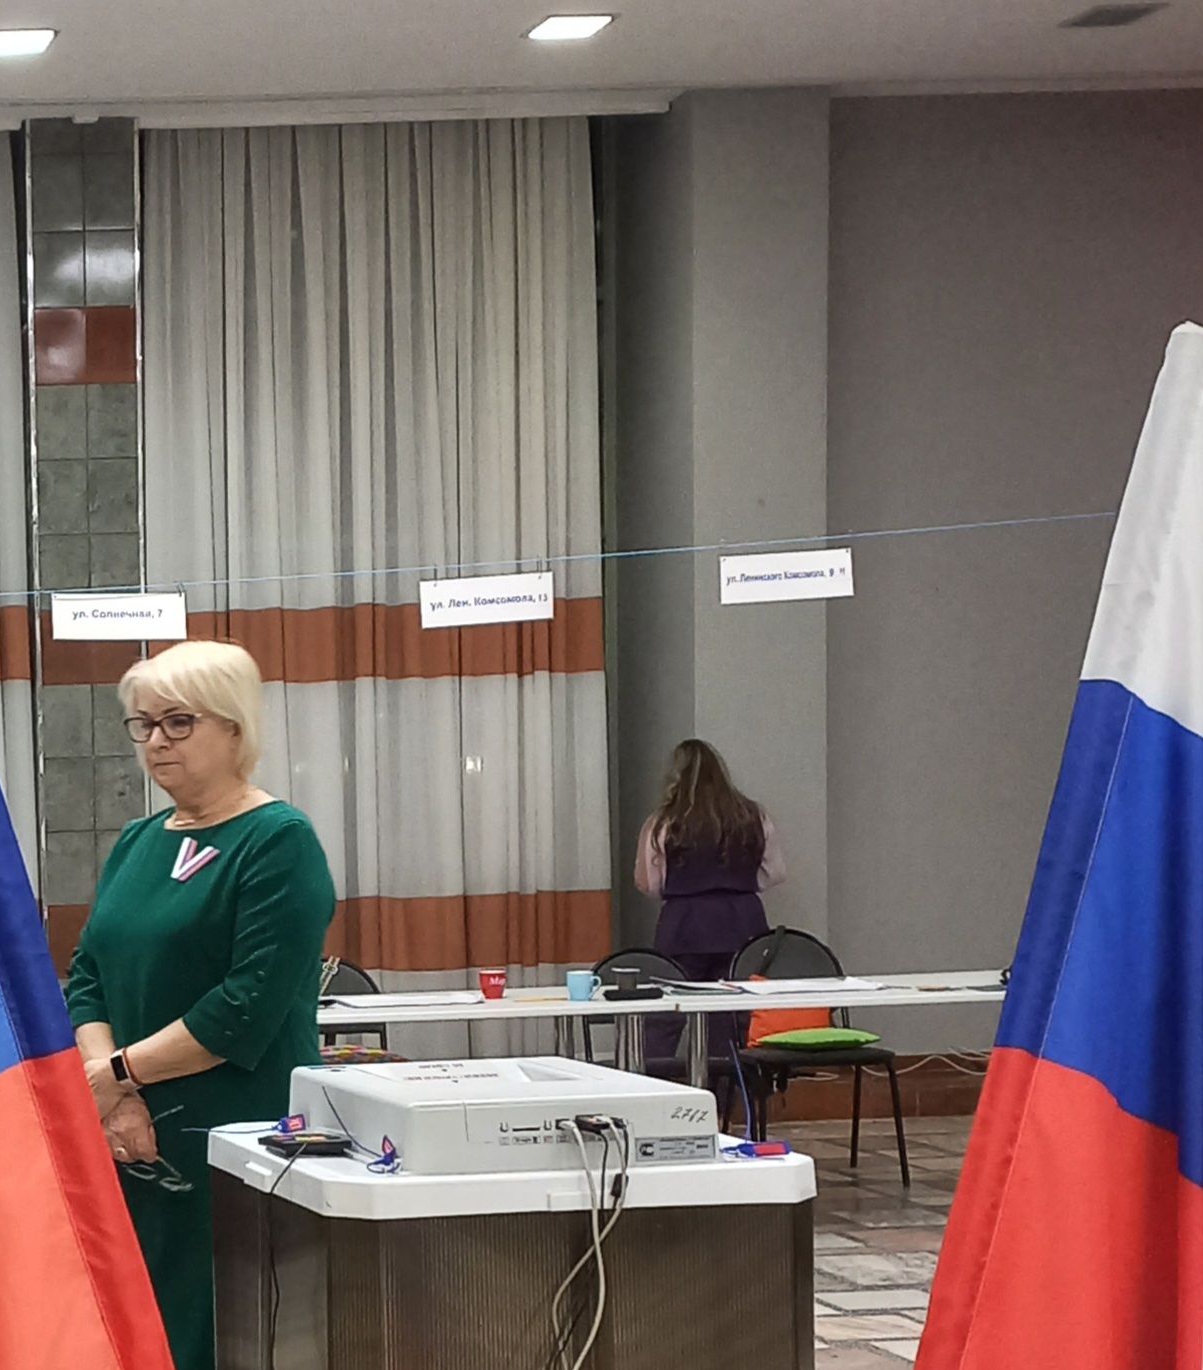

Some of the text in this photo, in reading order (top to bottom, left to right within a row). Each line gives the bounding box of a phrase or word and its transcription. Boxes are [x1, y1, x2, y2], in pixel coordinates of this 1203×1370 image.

[448, 599, 472, 608] Лен.
[474, 594, 536, 606] Комсомола,
[72, 609, 163, 620] ул. Солнечная, 7
